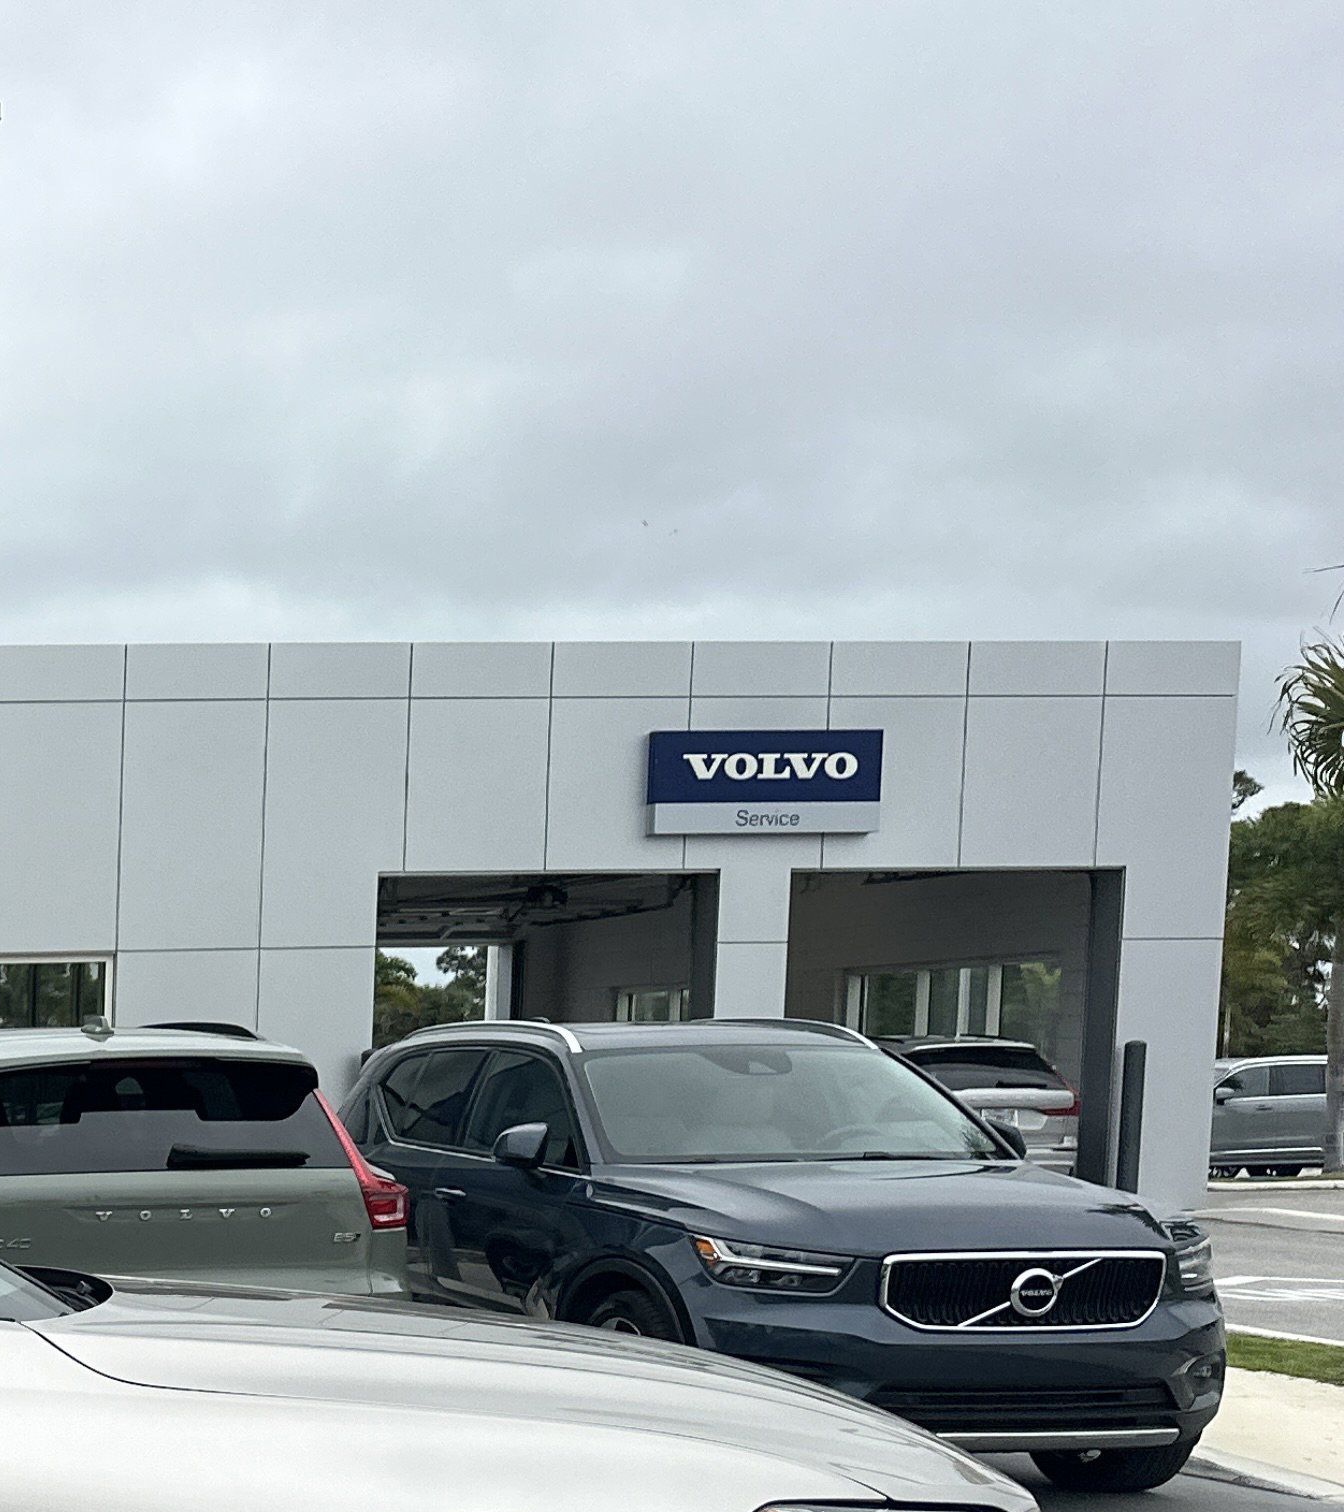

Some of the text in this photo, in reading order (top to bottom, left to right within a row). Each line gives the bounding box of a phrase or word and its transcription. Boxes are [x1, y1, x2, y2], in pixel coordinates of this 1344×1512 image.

[682, 751, 859, 780] VOLVO
[734, 809, 800, 827] Service
[96, 1206, 273, 1222] VOLVO
